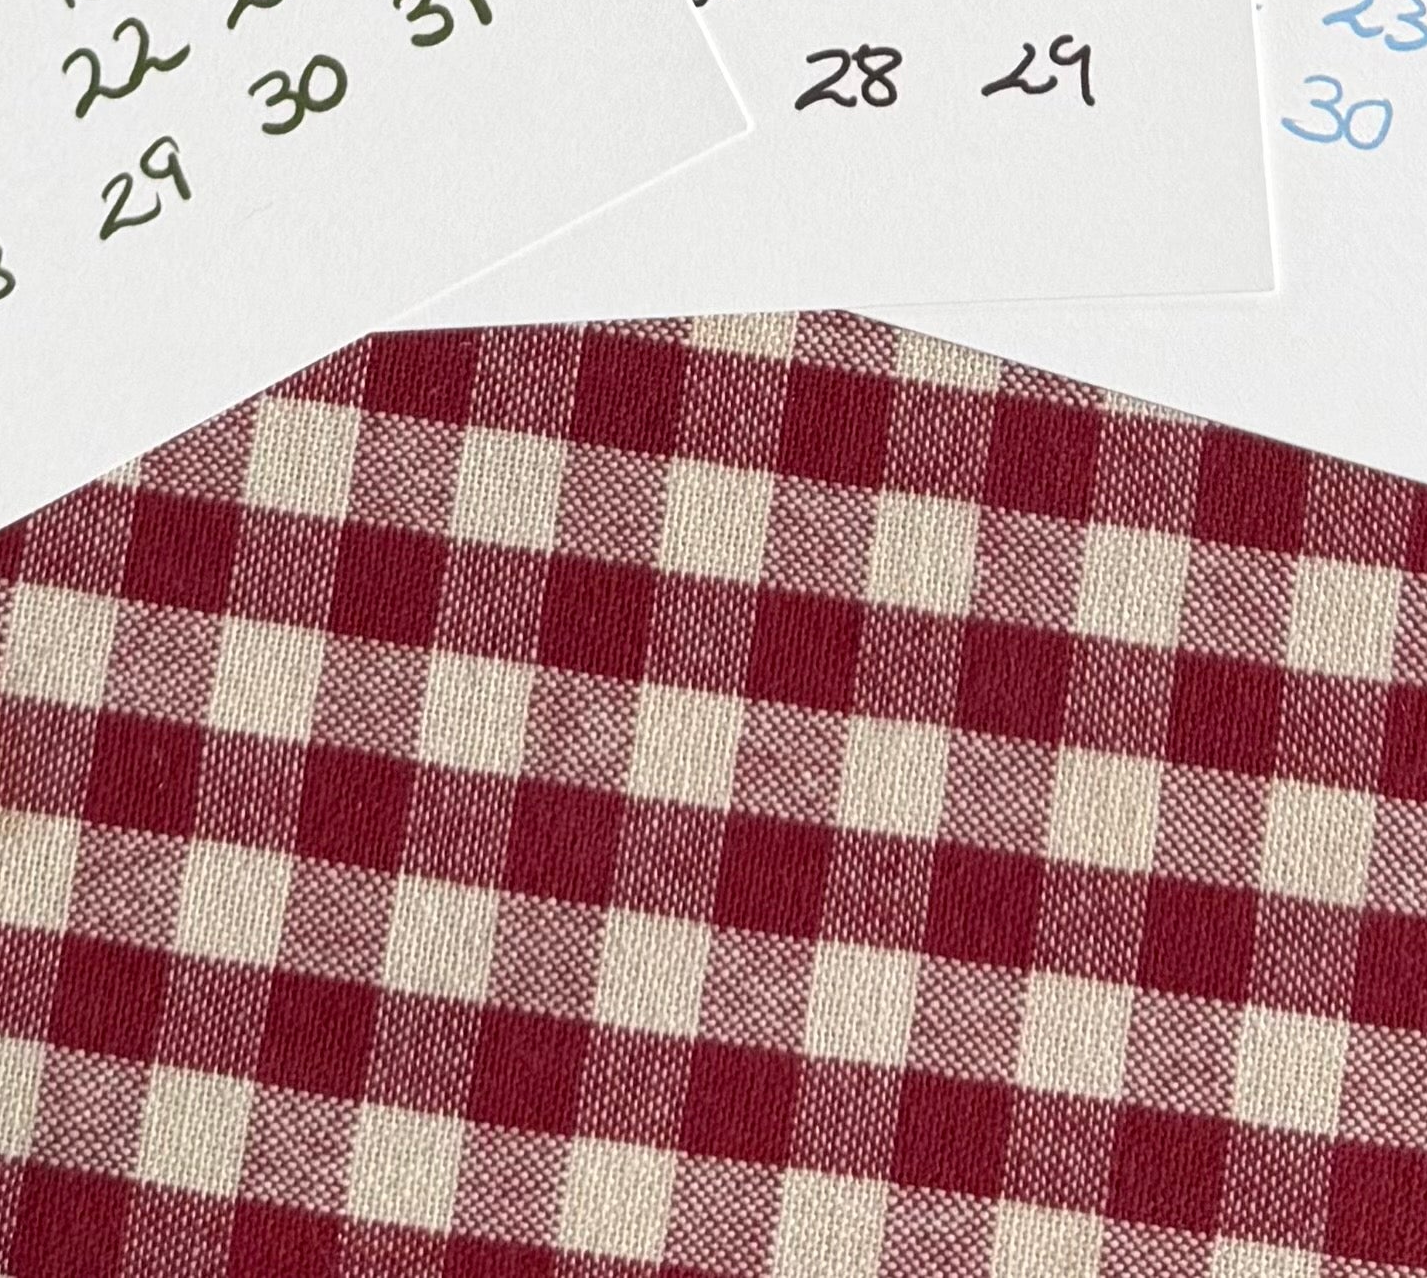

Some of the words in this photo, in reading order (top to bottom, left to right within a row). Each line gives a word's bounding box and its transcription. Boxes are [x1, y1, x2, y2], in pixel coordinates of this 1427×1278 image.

[60, 16, 192, 120] 22
[793, 42, 904, 112] 28
[980, 33, 1096, 108] 29
[1280, 74, 1394, 151] 30
[98, 135, 193, 242] 29
[246, 53, 349, 137] 30
